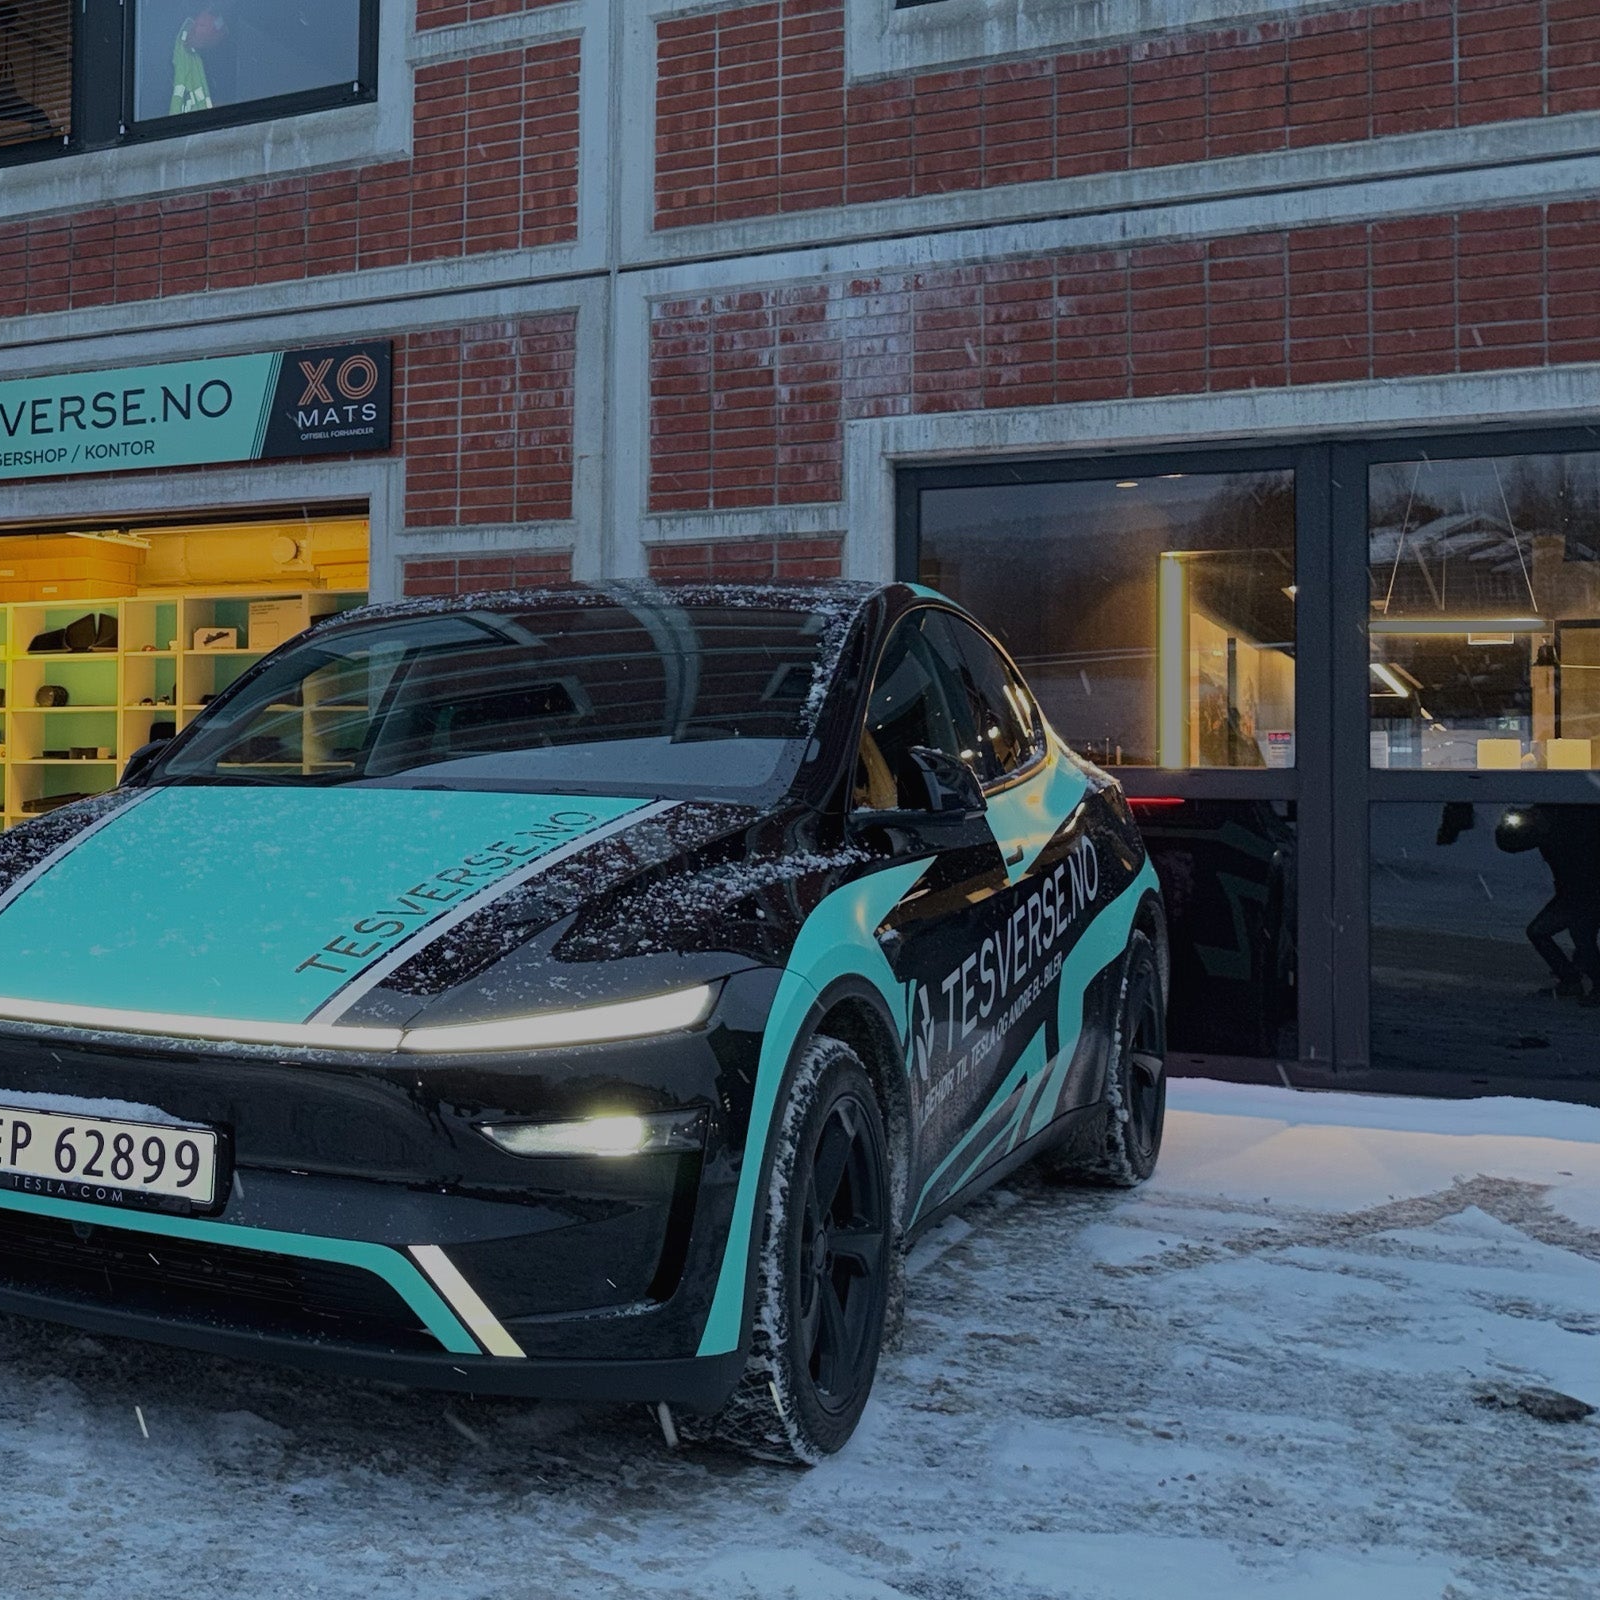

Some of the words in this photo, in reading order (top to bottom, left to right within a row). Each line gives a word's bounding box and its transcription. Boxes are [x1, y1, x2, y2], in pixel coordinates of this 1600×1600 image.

[297, 354, 379, 406] XO
[298, 403, 377, 428] MATS
[330, 427, 375, 438] FORHANDLER
[71, 445, 81, 463] /
[85, 440, 155, 460] KONTOR
[295, 810, 597, 974] TESVERSE.NO
[941, 835, 1099, 1054] TESVERSE.NO
[971, 1025, 996, 1070] TESLA
[996, 1011, 1009, 1042] OG
[54, 1126, 200, 1188] 62899
[14, 1175, 124, 1203] TESLA.COM
